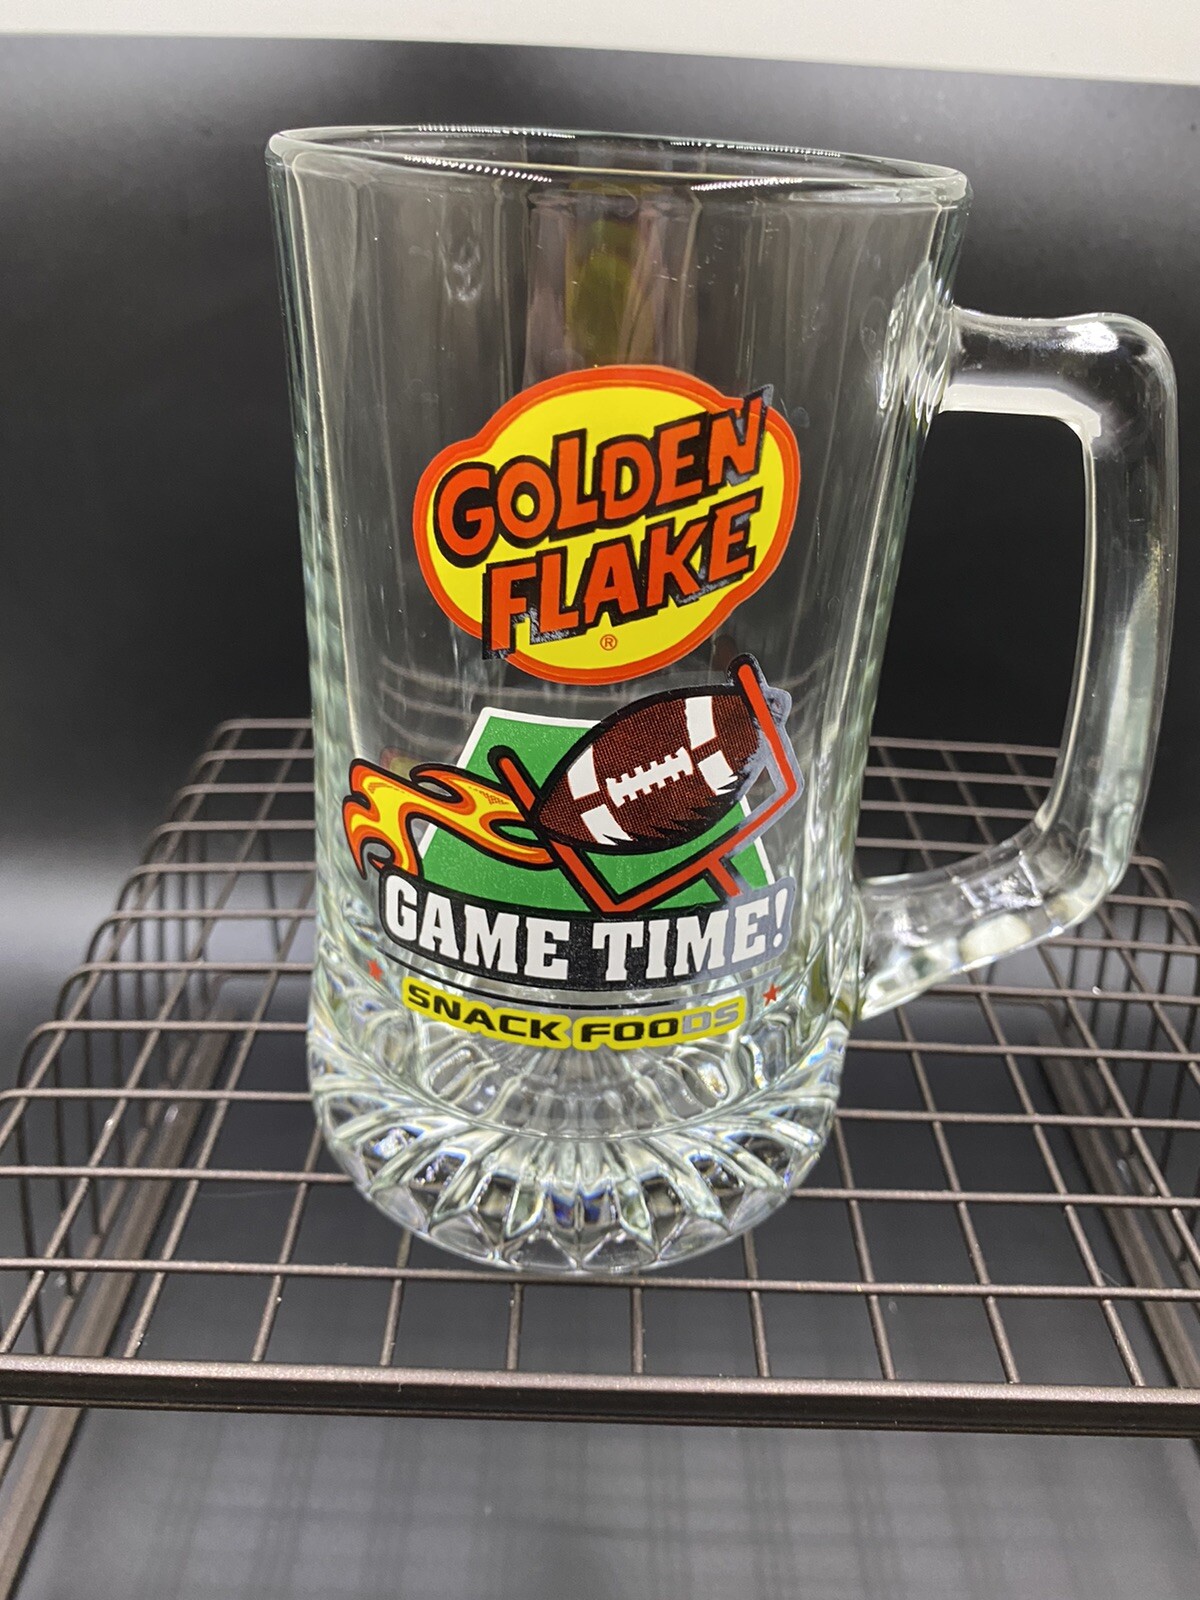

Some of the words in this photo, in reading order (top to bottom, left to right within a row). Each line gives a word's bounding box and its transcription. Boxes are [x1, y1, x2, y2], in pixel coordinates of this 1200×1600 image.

[435, 390, 769, 562] GOLDEN
[484, 491, 762, 657] FLAKE
[385, 874, 571, 981] GAME
[592, 890, 787, 982] TIME!
[408, 983, 566, 1042] SNACK
[581, 1001, 740, 1043] FOODS
